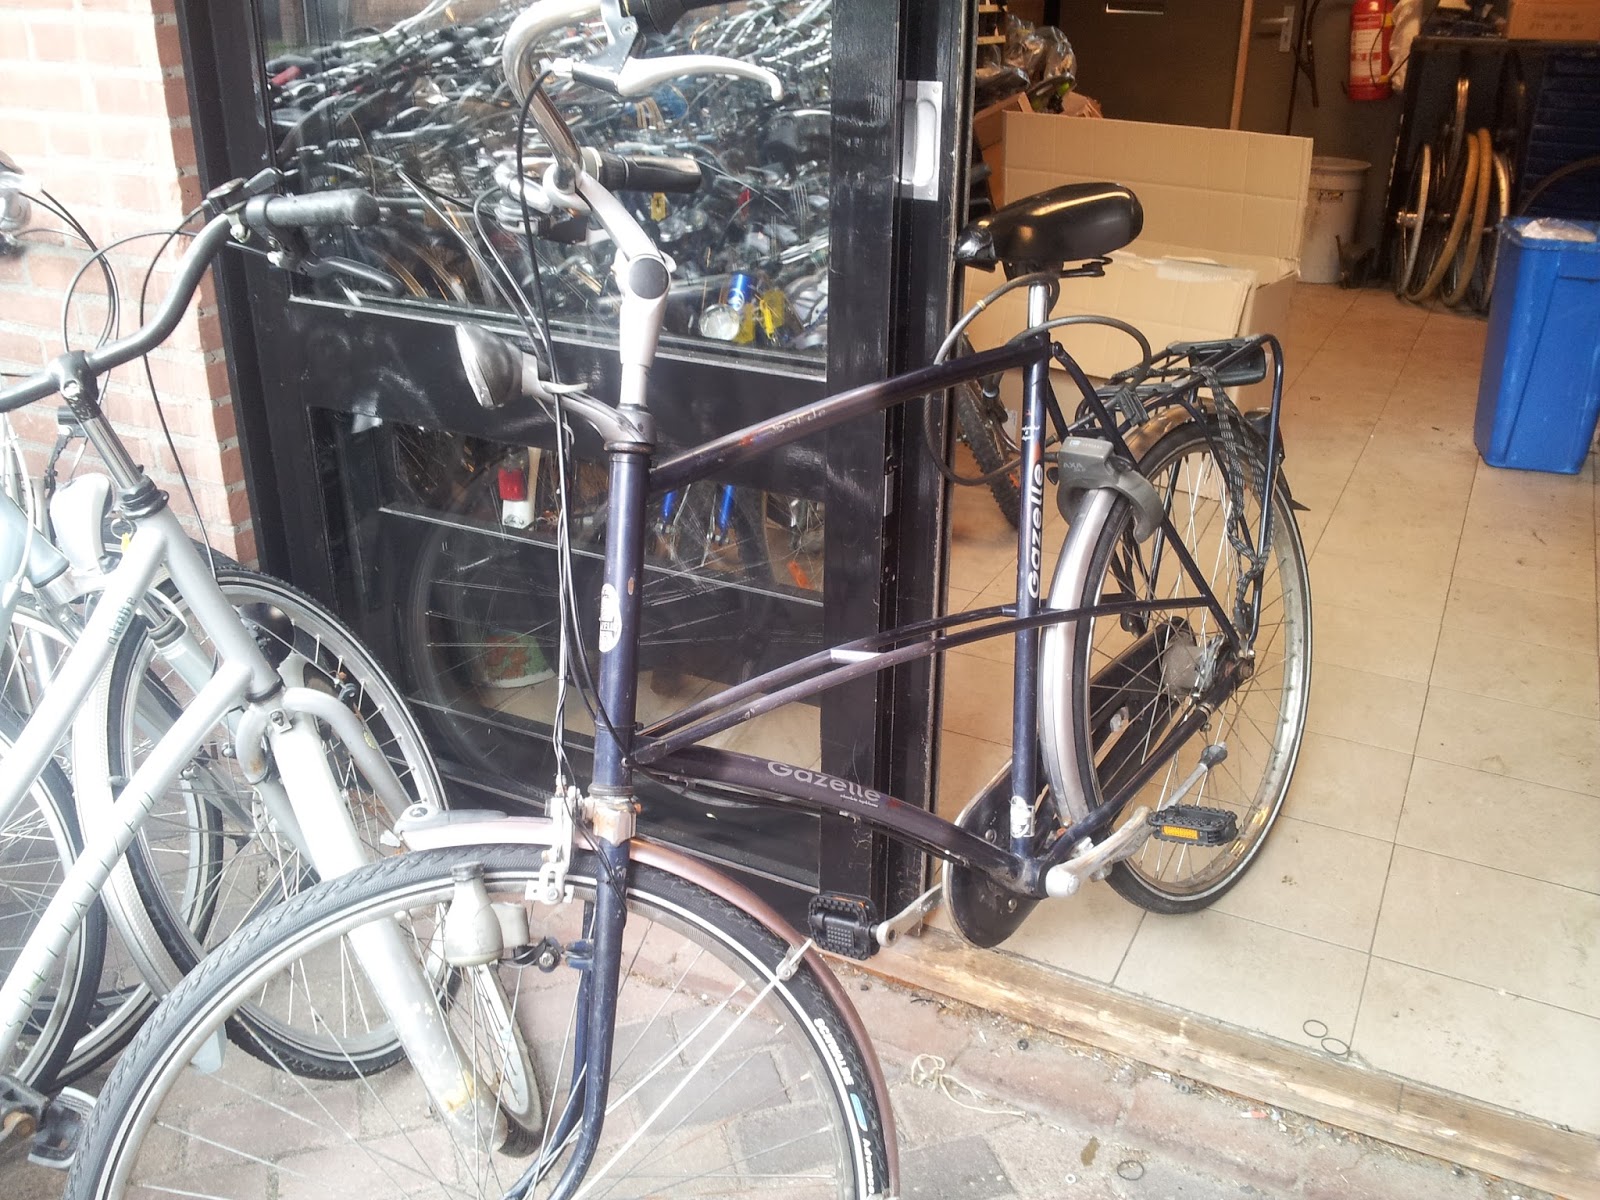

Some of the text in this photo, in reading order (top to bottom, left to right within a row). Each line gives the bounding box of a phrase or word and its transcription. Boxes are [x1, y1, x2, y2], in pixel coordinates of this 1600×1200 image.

[1027, 463, 1044, 599] Gazelle
[767, 761, 881, 802] Gazelle
[813, 1017, 855, 1086] SCHWALBE
